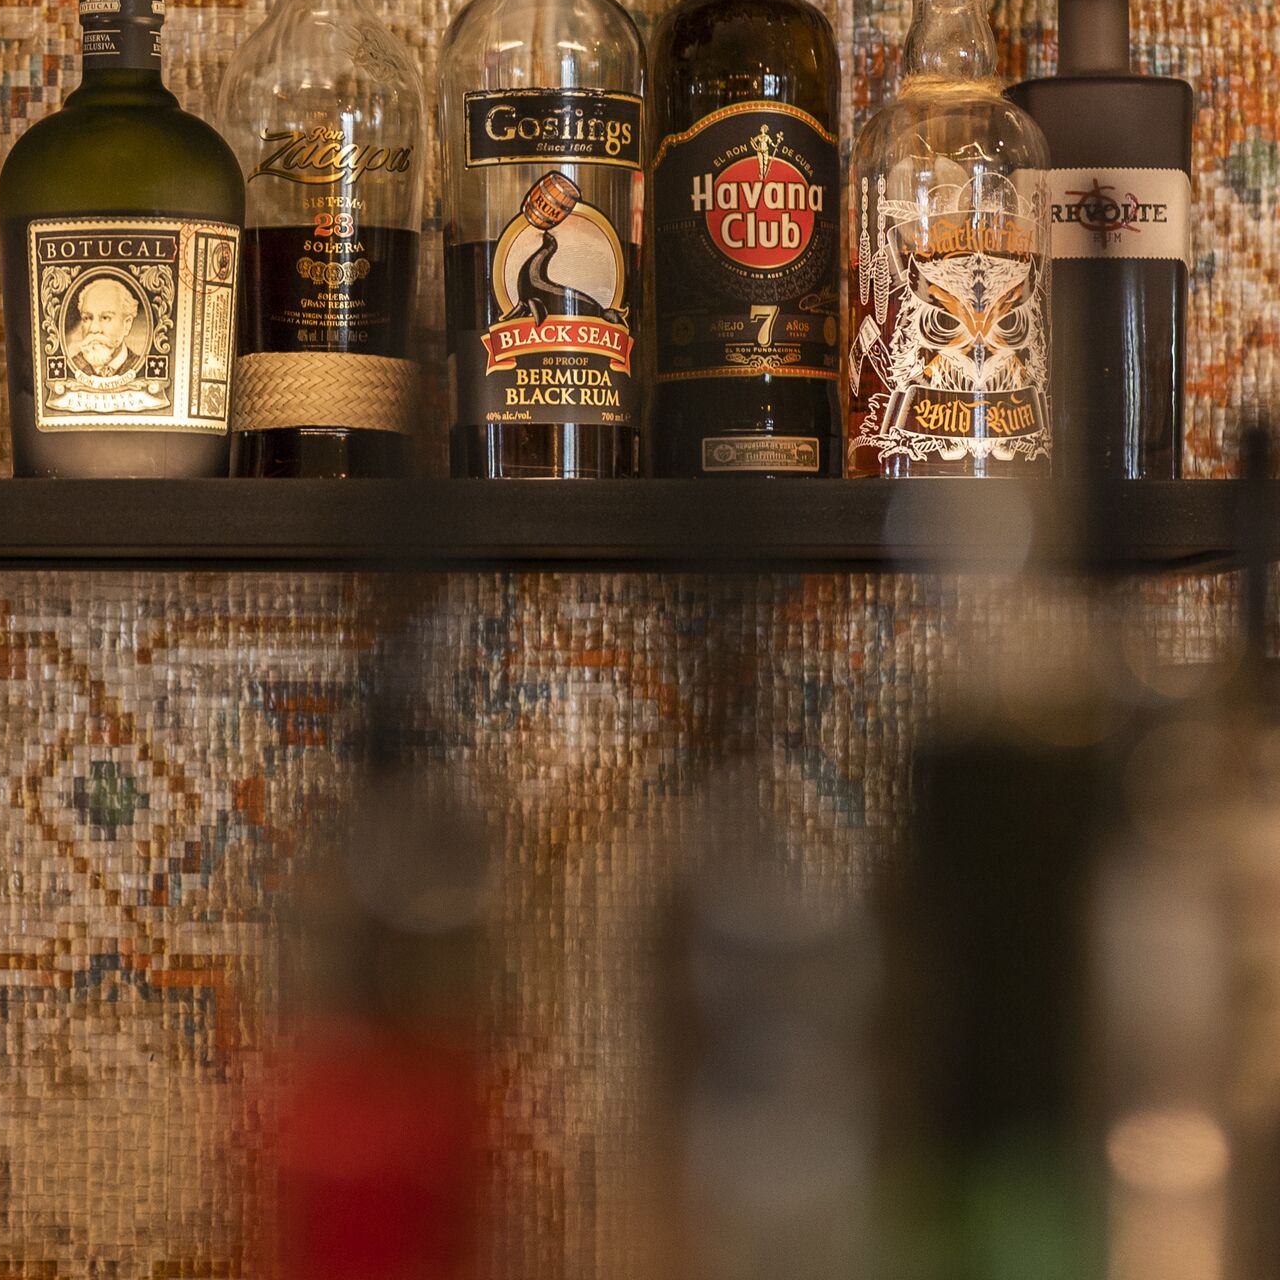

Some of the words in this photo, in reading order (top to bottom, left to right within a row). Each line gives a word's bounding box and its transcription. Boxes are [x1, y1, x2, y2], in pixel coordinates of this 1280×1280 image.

[307, 125, 346, 143] Ron
[484, 104, 632, 156] Goslings
[535, 142, 566, 152] Since
[569, 143, 594, 153] 1806
[247, 127, 412, 185] Zacapa
[713, 156, 725, 168] EL
[725, 144, 748, 159] RON
[781, 145, 794, 156] DE
[794, 154, 815, 178] CUBA
[691, 173, 823, 212] Havana
[302, 196, 368, 211] SISTEMA
[534, 194, 563, 220] RUM
[1051, 203, 1168, 223] REVOLTE
[313, 211, 355, 239] 23
[721, 211, 801, 249] Club
[1093, 232, 1123, 244] RUM
[46, 240, 166, 259] BOTUCAL
[303, 240, 365, 254] SOLERA
[300, 298, 327, 309] GRAN
[327, 300, 367, 309] RESERVA
[317, 292, 351, 301] SOLERA
[301, 311, 322, 320] VIRGIN
[324, 313, 344, 321] SUGAR
[319, 319, 348, 327] ALTITUDE
[710, 320, 745, 333] AÑEJO
[749, 304, 780, 348] 7
[785, 319, 810, 333] AÑOS
[498, 325, 573, 350] BLACK
[577, 325, 622, 351] SEAL
[542, 357, 554, 366] 80
[555, 357, 589, 366] PROOF
[515, 368, 613, 387] BERMUDA
[68, 398, 144, 410] EXCLUSIVA
[77, 392, 134, 401] RESERVA
[505, 387, 579, 406] BLACK
[579, 388, 621, 407] RUM
[501, 410, 532, 421] alc./vol.
[601, 411, 615, 421] 700
[914, 400, 978, 433] Wild
[986, 396, 1036, 435] Rum
